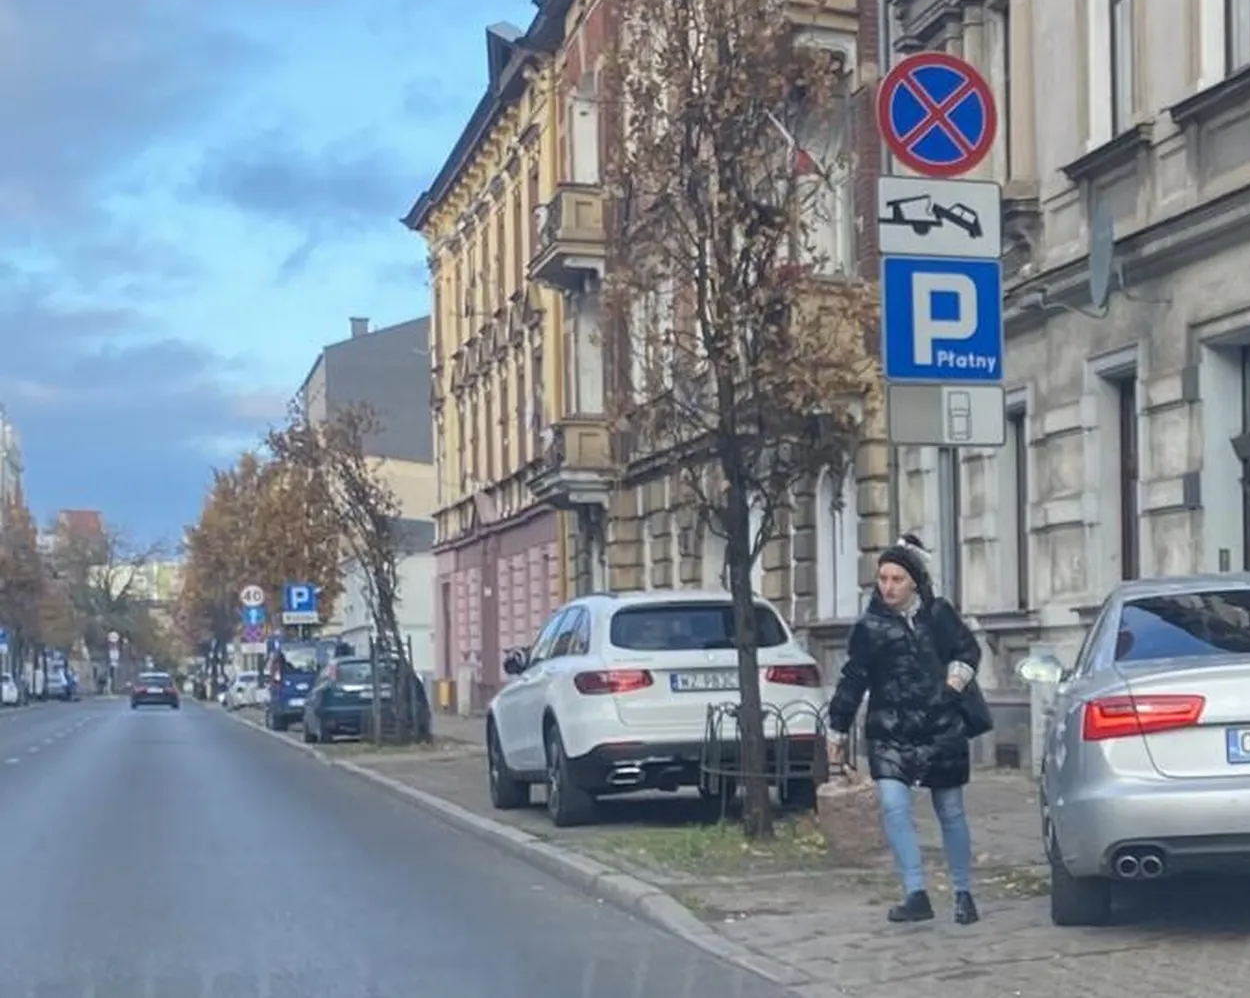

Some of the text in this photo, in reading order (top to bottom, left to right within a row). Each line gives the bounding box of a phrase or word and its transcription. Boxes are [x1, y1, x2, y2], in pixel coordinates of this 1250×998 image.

[912, 271, 978, 366] P
[936, 350, 997, 373] Płatny
[243, 589, 262, 602] 40
[291, 587, 309, 610] P
